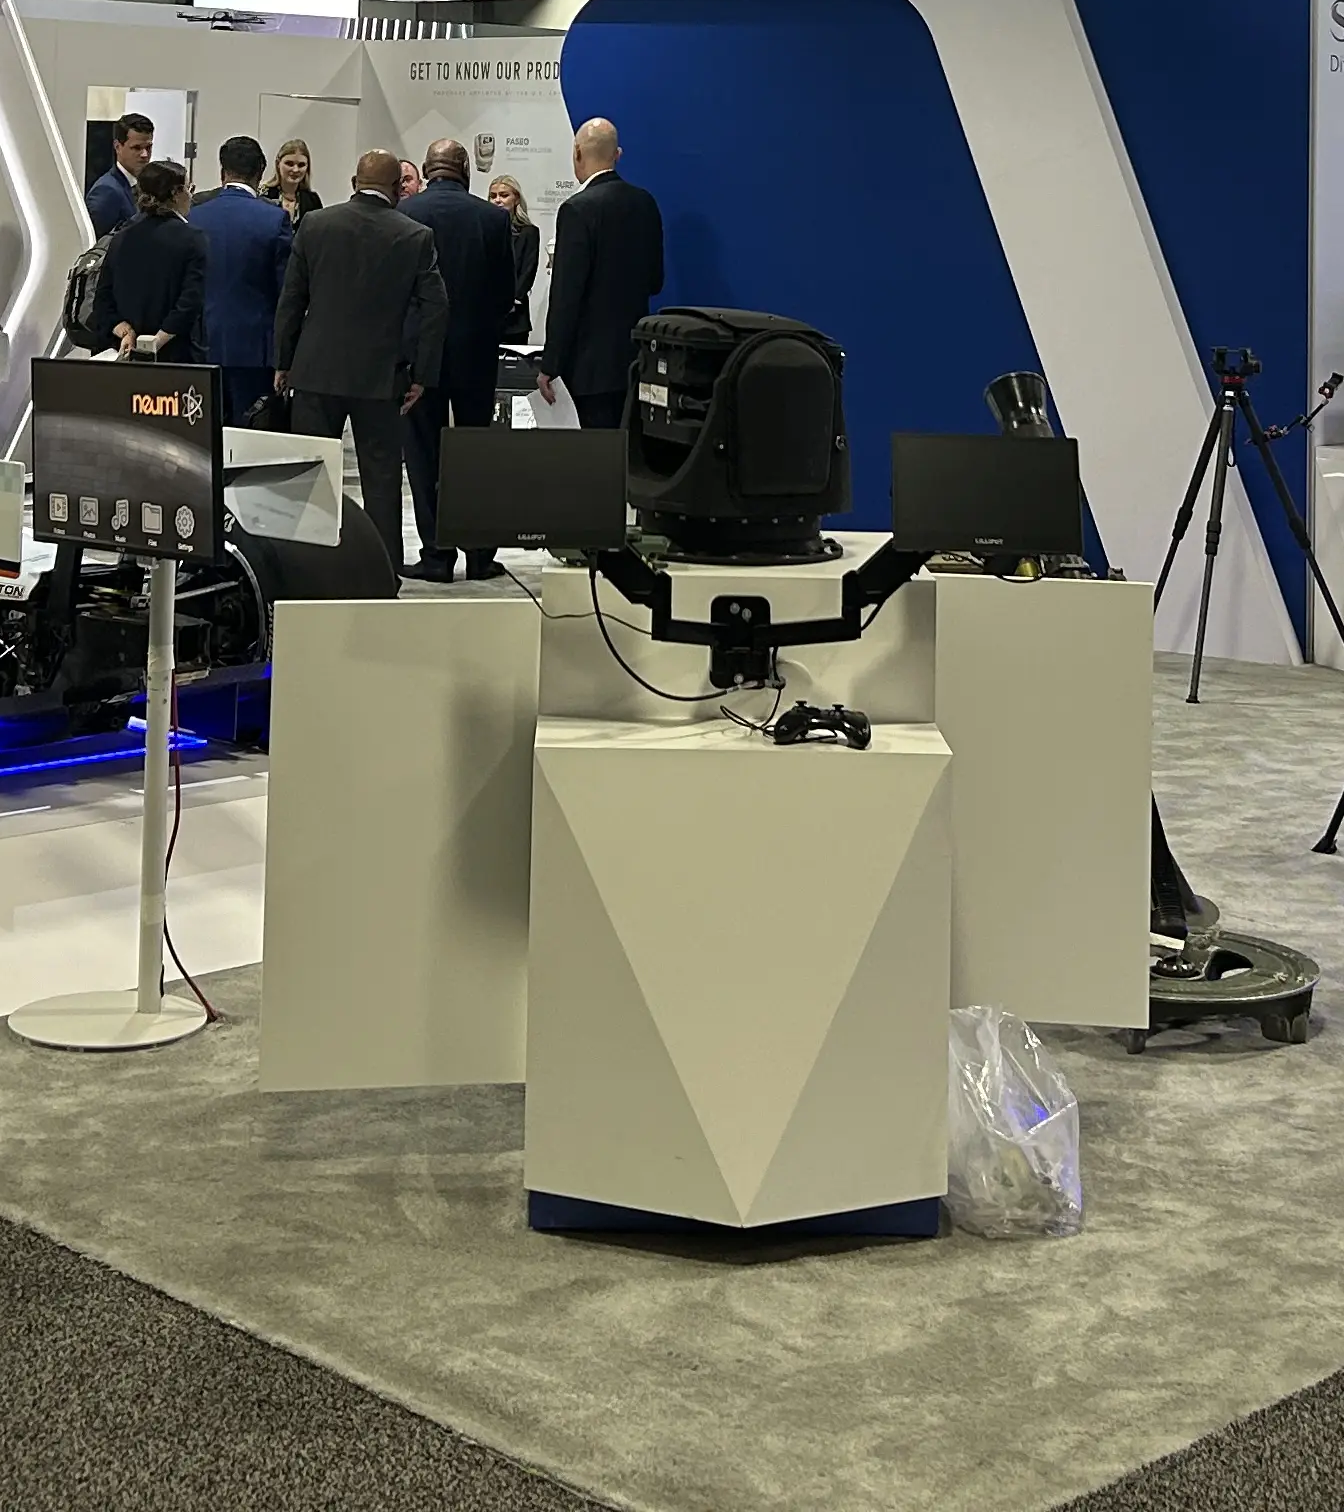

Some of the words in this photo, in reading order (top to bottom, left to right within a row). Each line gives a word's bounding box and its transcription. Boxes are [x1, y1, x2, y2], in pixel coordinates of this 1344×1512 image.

[410, 62, 431, 80] GET
[436, 62, 450, 80] TO
[456, 61, 491, 80] KNOW
[496, 61, 521, 80] OUR
[132, 393, 179, 418] neumi
